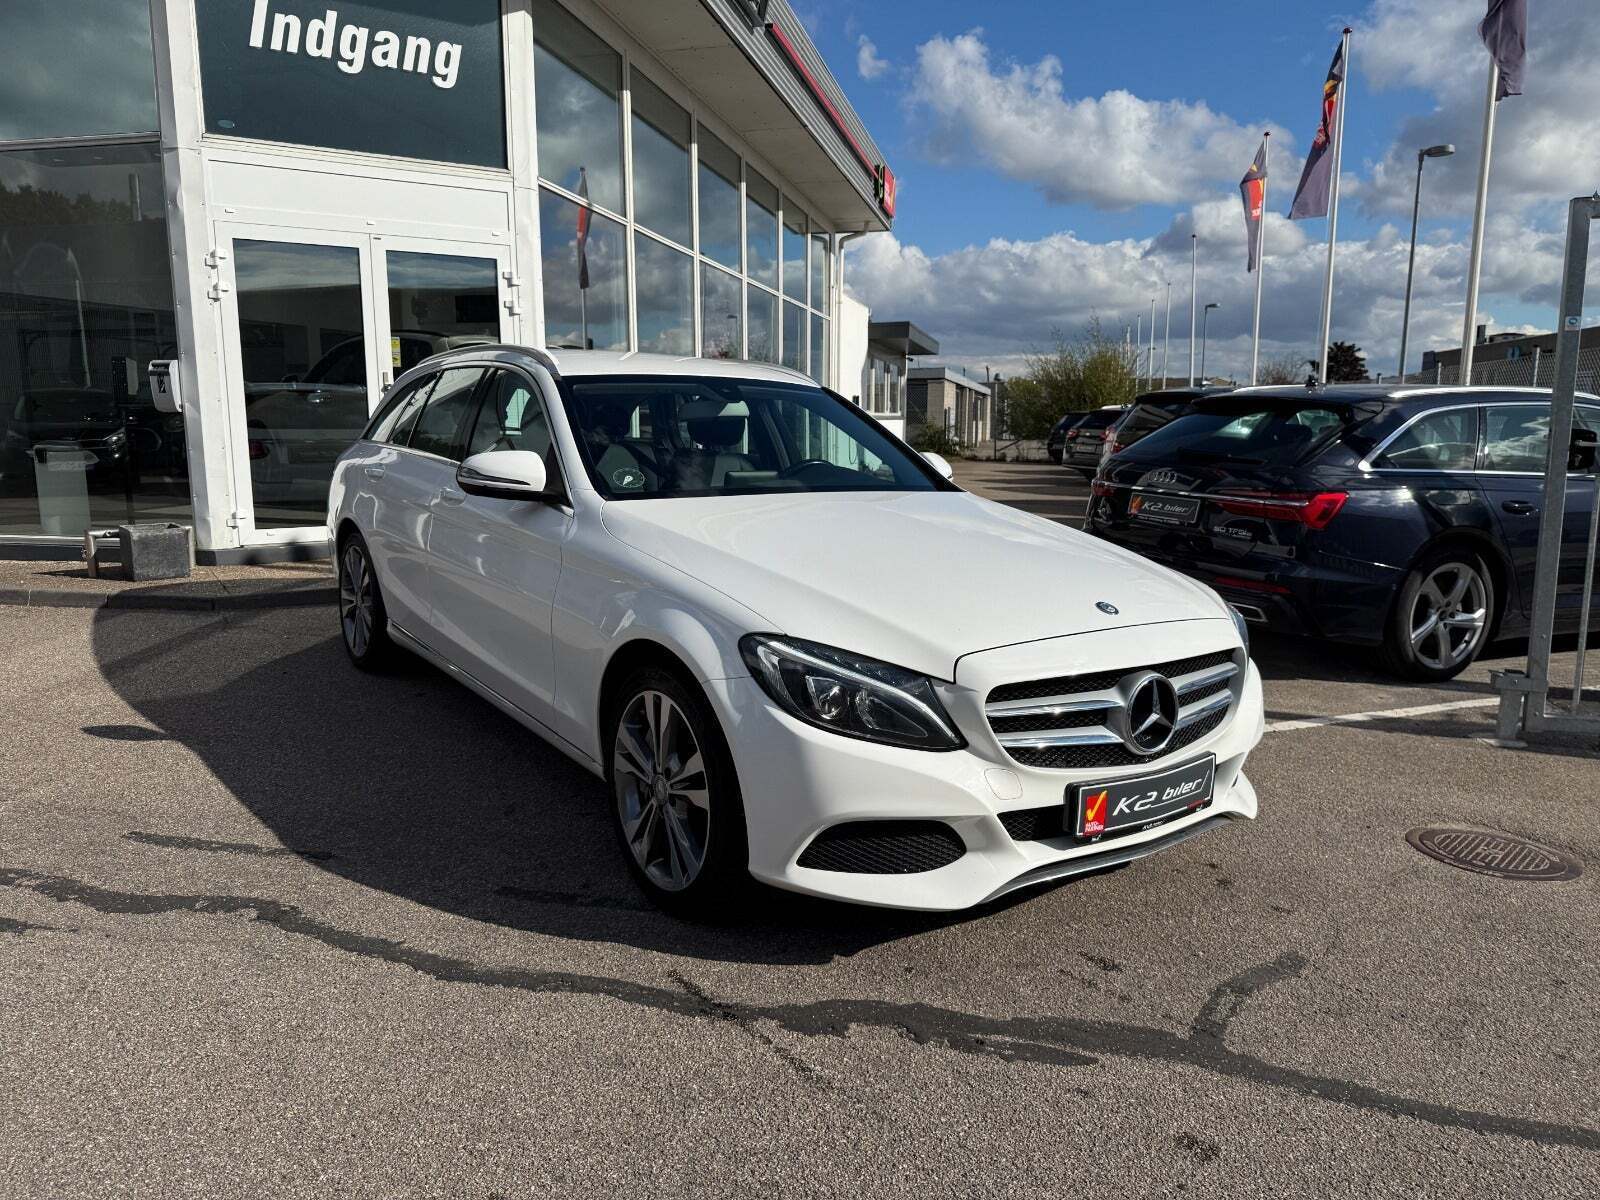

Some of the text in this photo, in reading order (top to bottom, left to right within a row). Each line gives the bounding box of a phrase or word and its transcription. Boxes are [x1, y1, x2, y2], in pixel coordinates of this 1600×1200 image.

[249, 0, 463, 89] Indgang
[1141, 501, 1163, 511] K2
[1112, 779, 1203, 816] K2 biler
